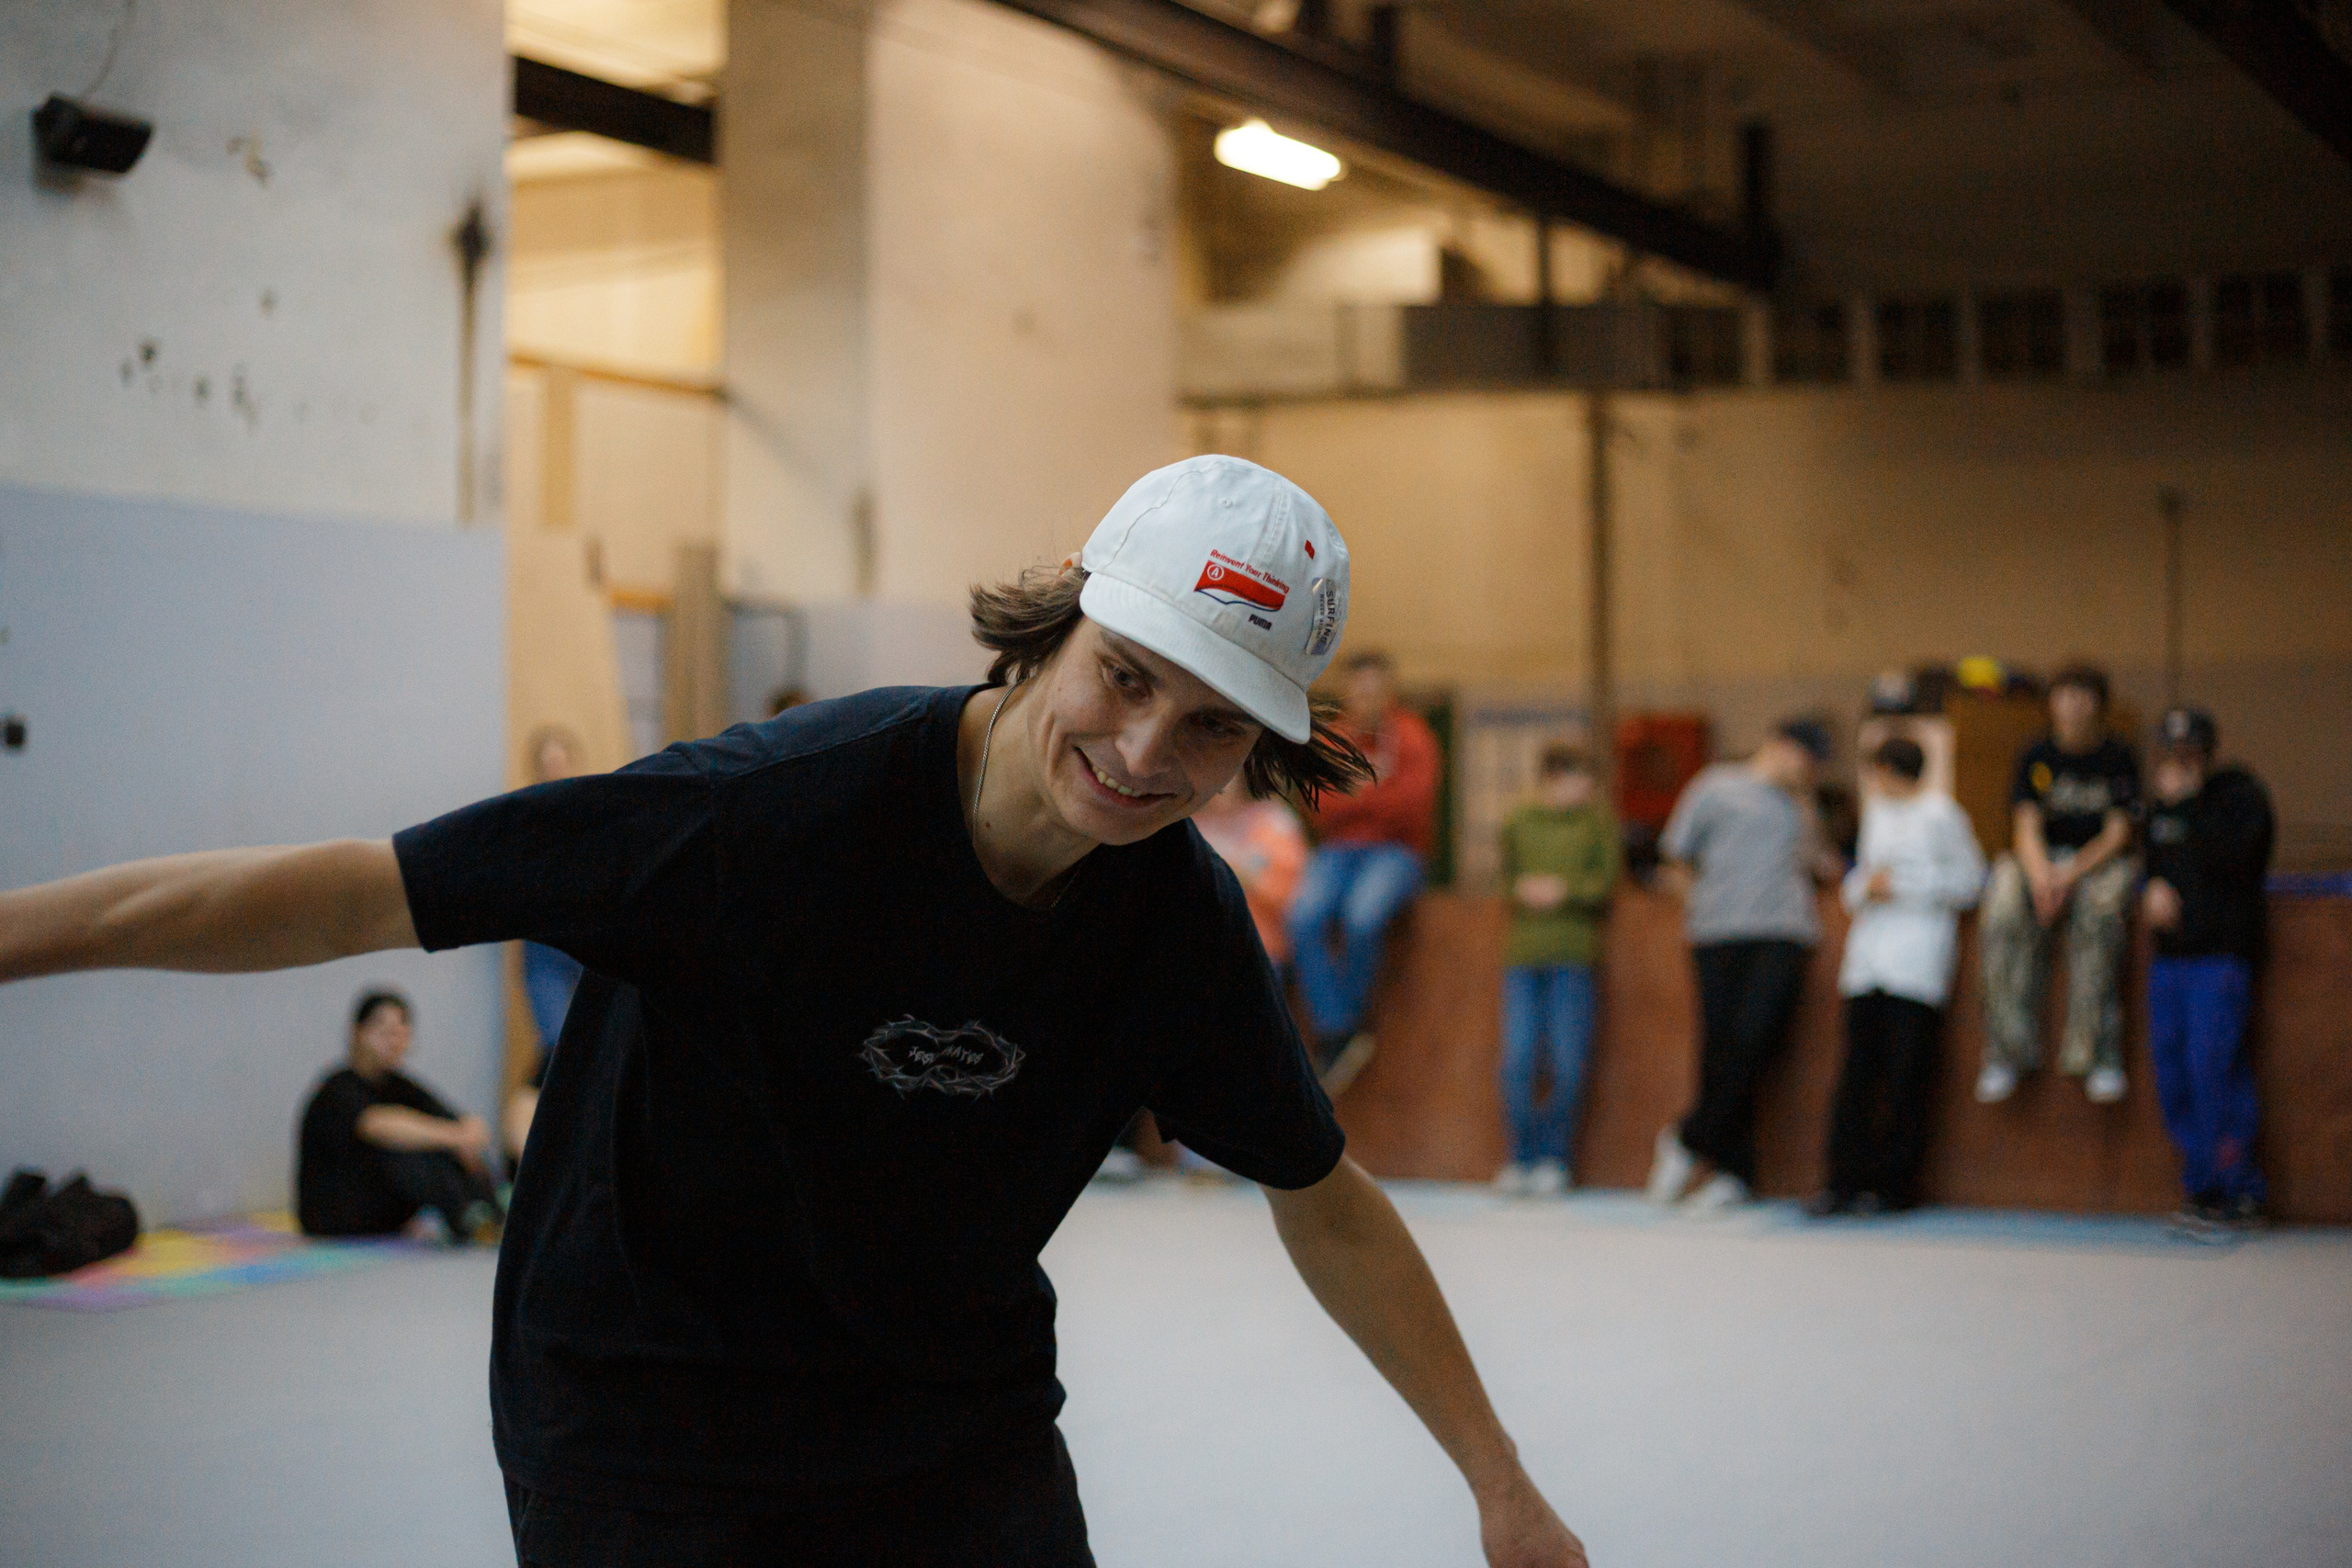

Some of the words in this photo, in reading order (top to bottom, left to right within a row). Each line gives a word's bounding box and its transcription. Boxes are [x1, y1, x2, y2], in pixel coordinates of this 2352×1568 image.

[1210, 548, 1245, 570] Reinvent
[1245, 563, 1262, 578] Your
[1262, 571, 1290, 594] Thinking
[1248, 614, 1272, 631] PUMA
[1320, 590, 1336, 644] SURFING
